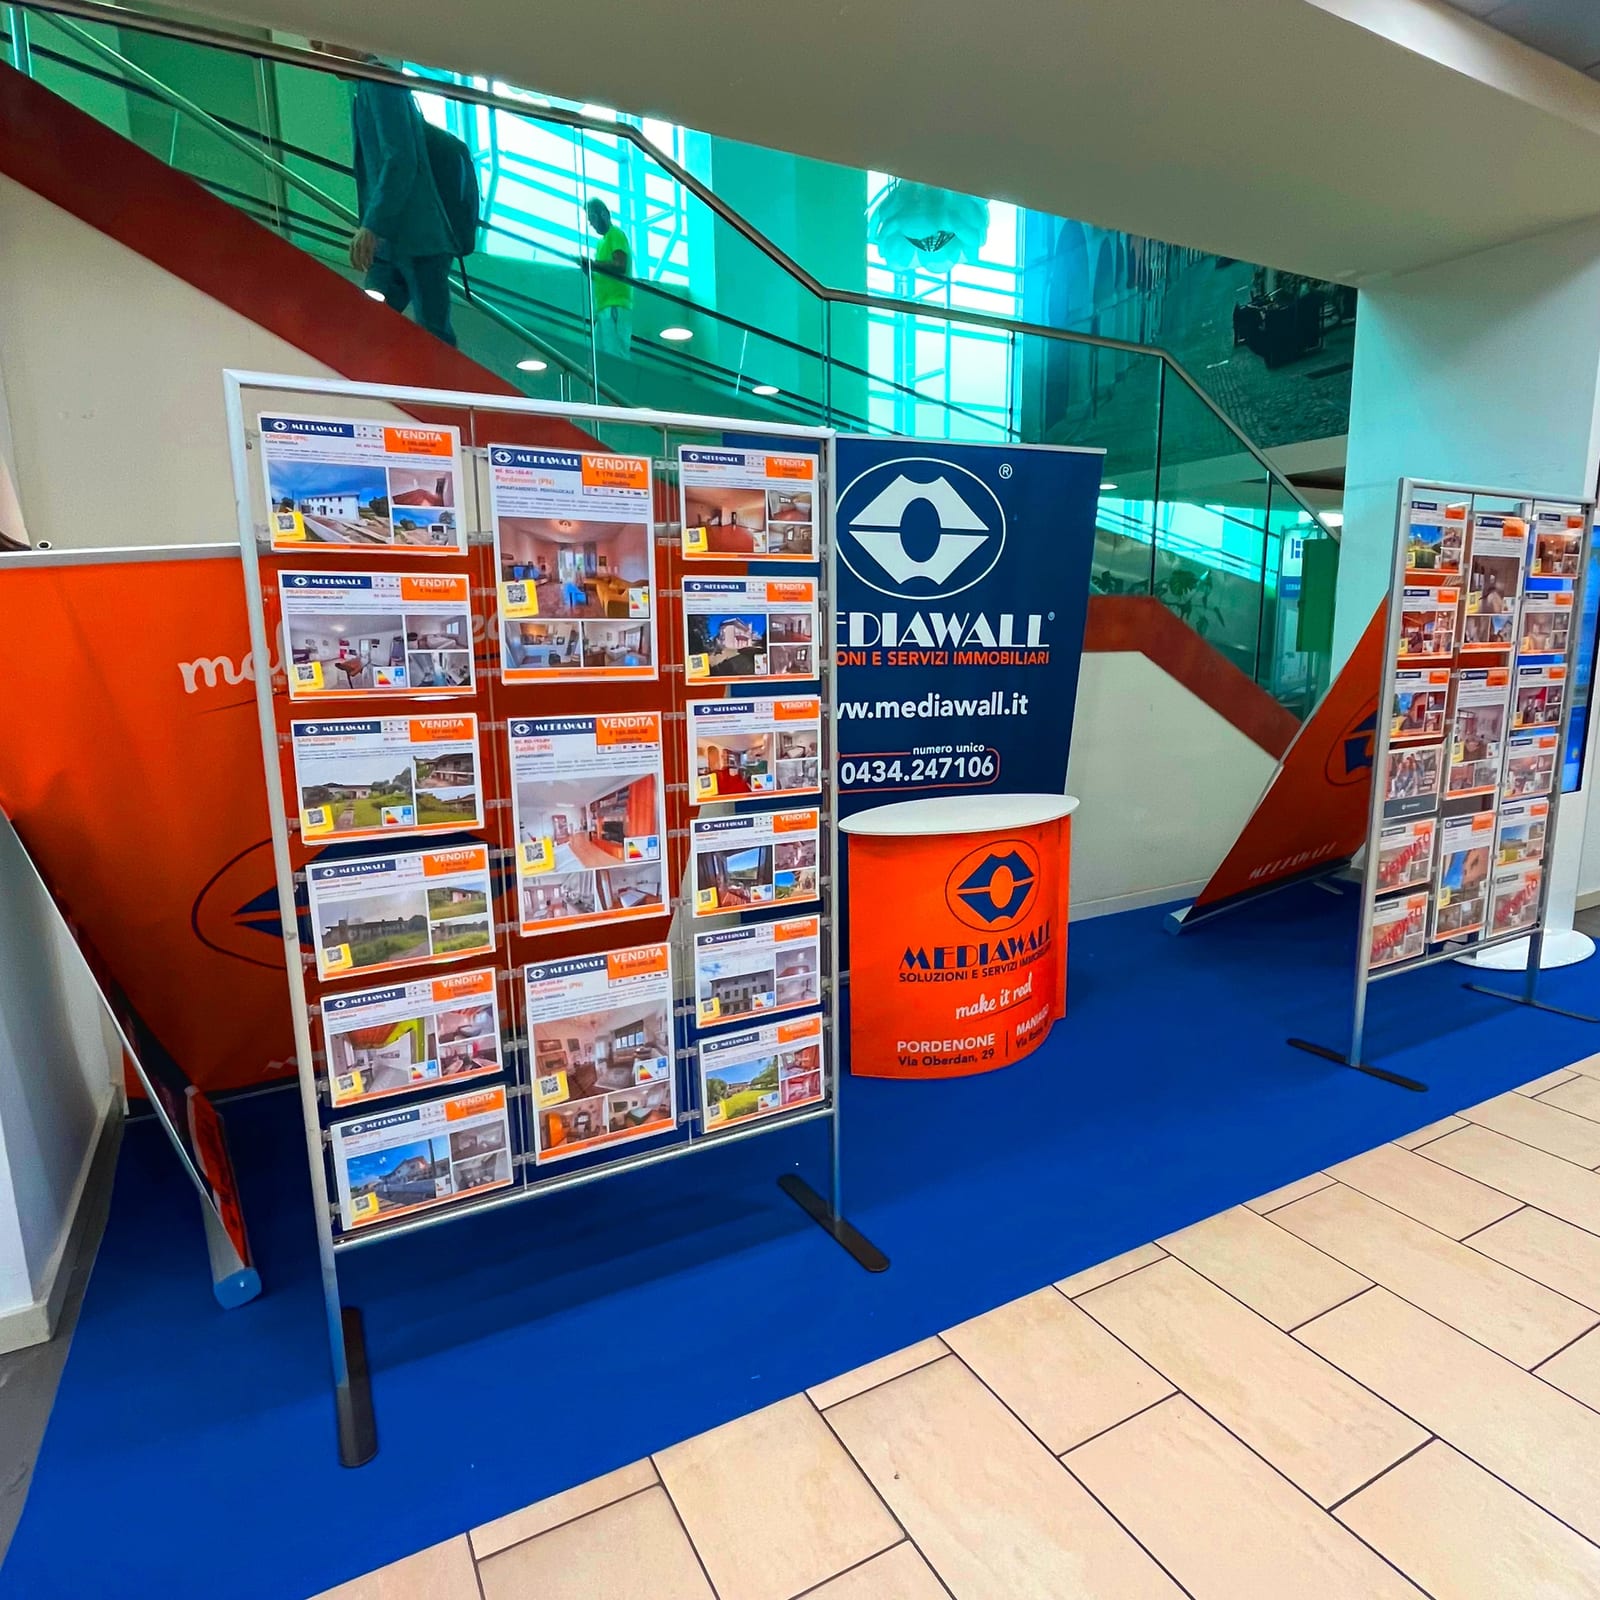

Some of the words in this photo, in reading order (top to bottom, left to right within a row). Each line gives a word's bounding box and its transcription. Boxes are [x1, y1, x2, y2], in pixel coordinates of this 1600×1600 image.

[394, 429, 443, 442] VENDITA
[587, 457, 643, 472] VENDITA
[774, 458, 806, 468] VENDITA
[412, 577, 457, 588] VENDITA
[774, 583, 806, 591] VENDITA
[872, 651, 881, 665] E
[887, 651, 948, 665] SERVIZI
[953, 651, 1049, 665] IMMOBILIARI
[781, 702, 813, 710] VENDITA
[419, 719, 464, 729] VENDITA
[601, 716, 655, 729] VENDITA
[913, 744, 952, 756] numero
[956, 742, 985, 753] unico
[841, 756, 994, 785] 0434.247106
[780, 813, 812, 822] VENDITA
[432, 850, 477, 863] VENDITA
[899, 919, 1051, 971] MEDIAWALL
[612, 948, 664, 964] VENDITA
[899, 970, 968, 983] SOLUZIONI
[971, 969, 979, 979] E
[982, 962, 1018, 978] SERVIZI
[441, 974, 485, 988] VENDITA
[955, 993, 997, 1020] make
[999, 986, 1011, 1008] it
[1013, 971, 1033, 1002] real
[897, 1033, 996, 1053] PORDENONE
[898, 1056, 918, 1067] Via
[982, 1049, 995, 1060] 29
[454, 1093, 496, 1108] VENDITA
